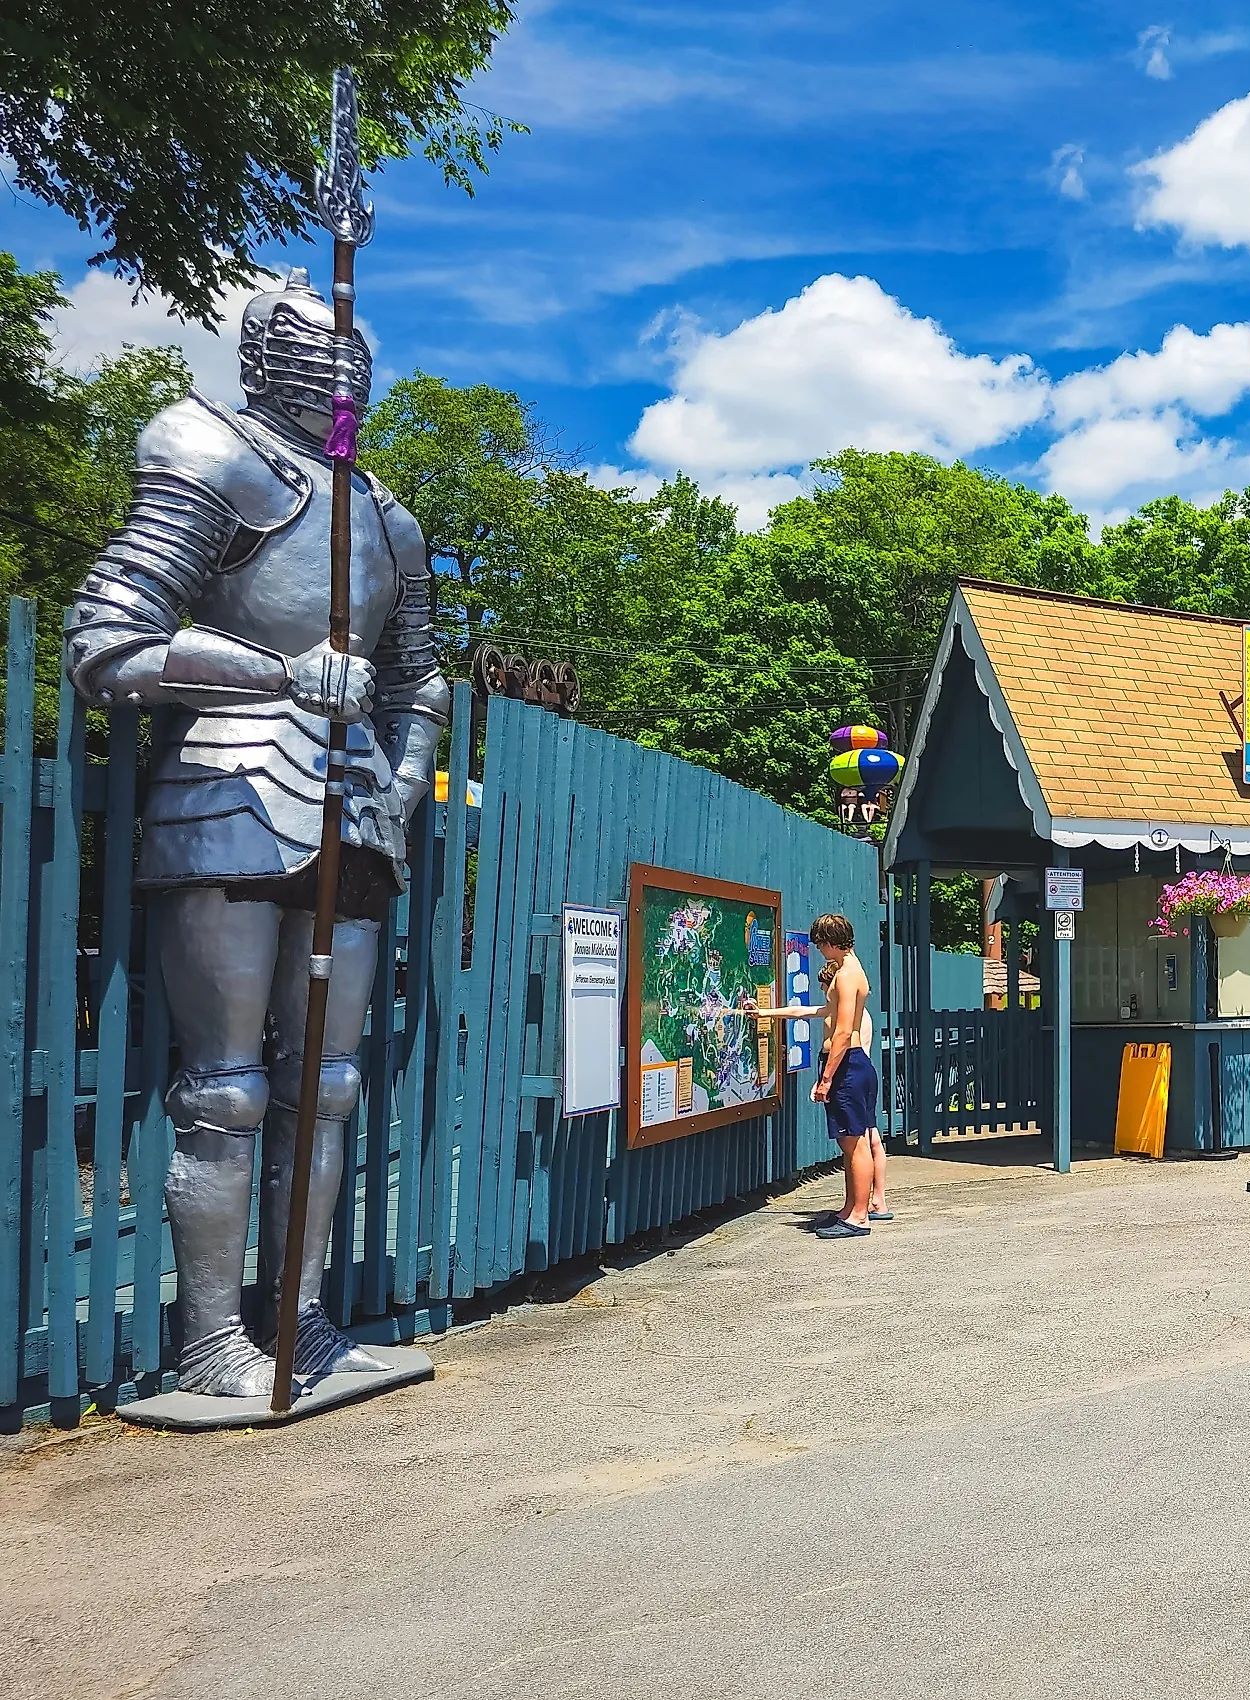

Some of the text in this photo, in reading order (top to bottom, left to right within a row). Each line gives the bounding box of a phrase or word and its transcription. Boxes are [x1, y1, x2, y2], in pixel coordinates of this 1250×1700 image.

[572, 917, 612, 937] WELCOME
[988, 935, 995, 944] 2
[574, 941, 618, 957] Donovan Middle School
[589, 975, 606, 986] Elementary
[605, 976, 616, 984] School
